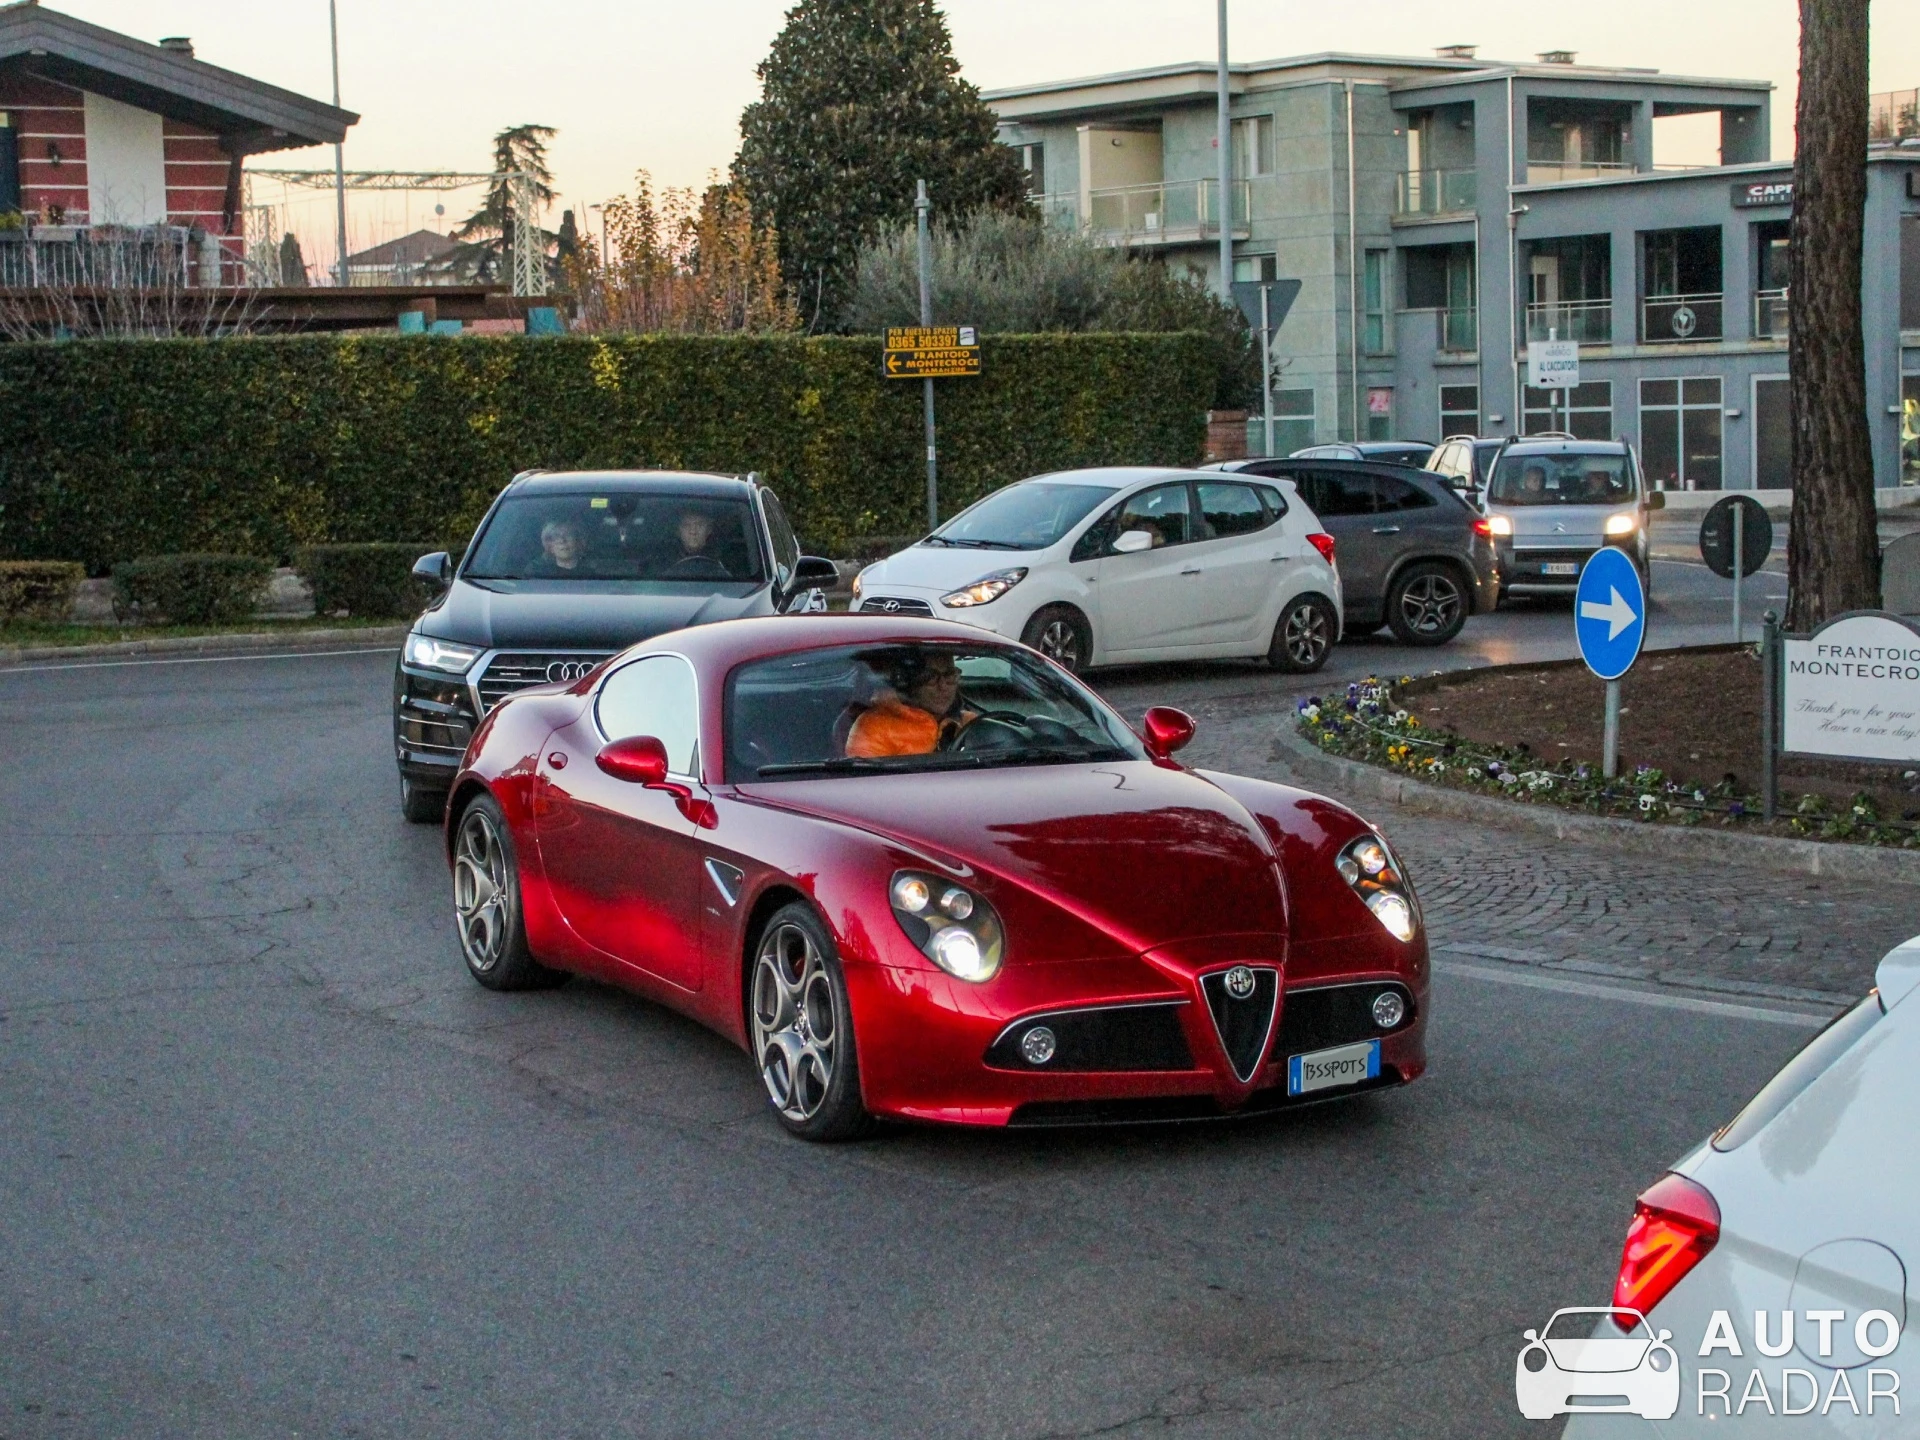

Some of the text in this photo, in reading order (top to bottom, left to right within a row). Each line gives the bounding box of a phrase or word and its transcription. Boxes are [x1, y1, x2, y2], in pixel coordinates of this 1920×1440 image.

[889, 327, 957, 336] PER QUESTO SPAZIO
[889, 335, 957, 348] 0365 503397
[914, 351, 970, 359] FRANTOIO
[906, 358, 978, 368] MONTECROCE
[1790, 661, 1919, 680] MONTECRO
[1794, 699, 1916, 722] Thank you for your
[1818, 719, 1848, 732] Have
[1865, 727, 1887, 735] nice
